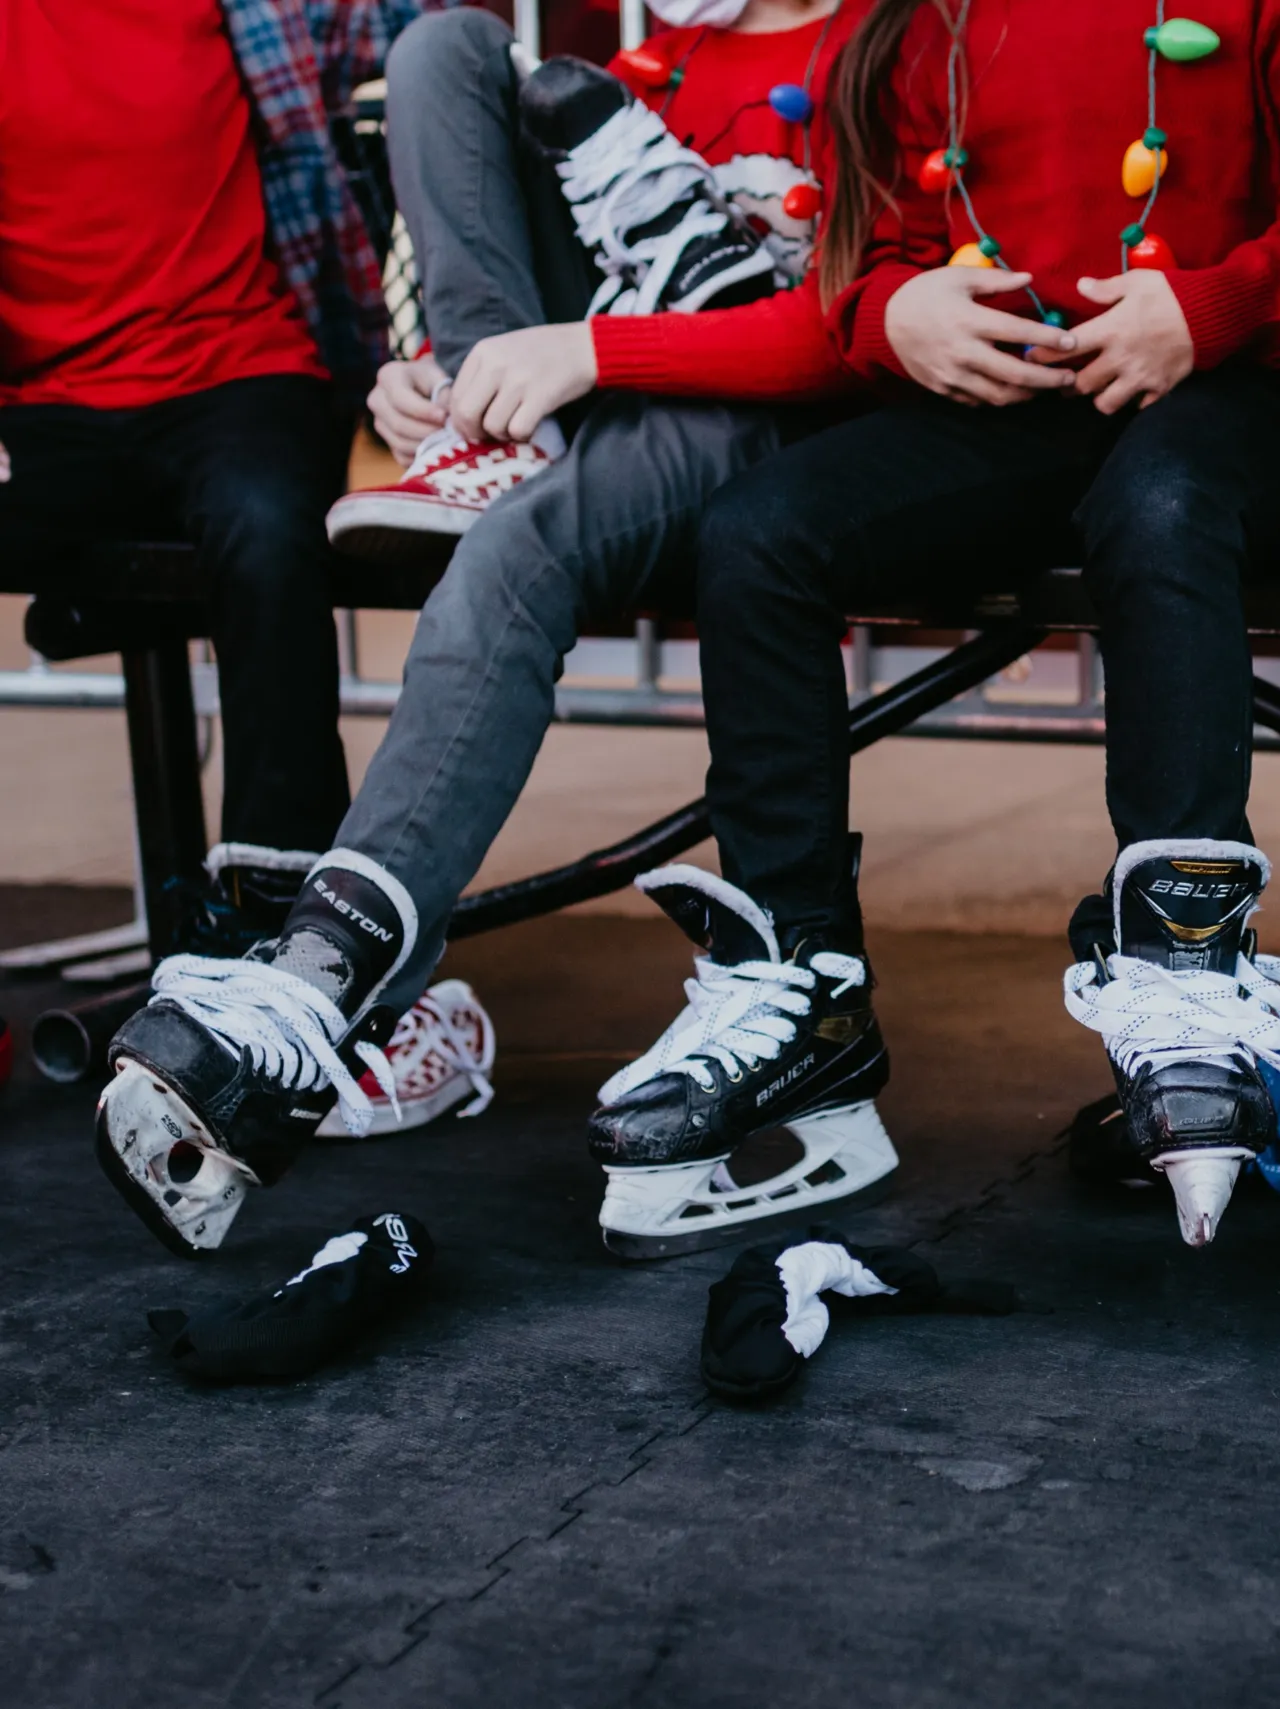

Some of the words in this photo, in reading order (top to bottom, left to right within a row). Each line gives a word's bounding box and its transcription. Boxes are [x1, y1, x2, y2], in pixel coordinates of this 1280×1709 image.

[313, 879, 394, 943] EASTON
[1148, 878, 1250, 899] BAUER
[756, 1052, 815, 1107] BAUER
